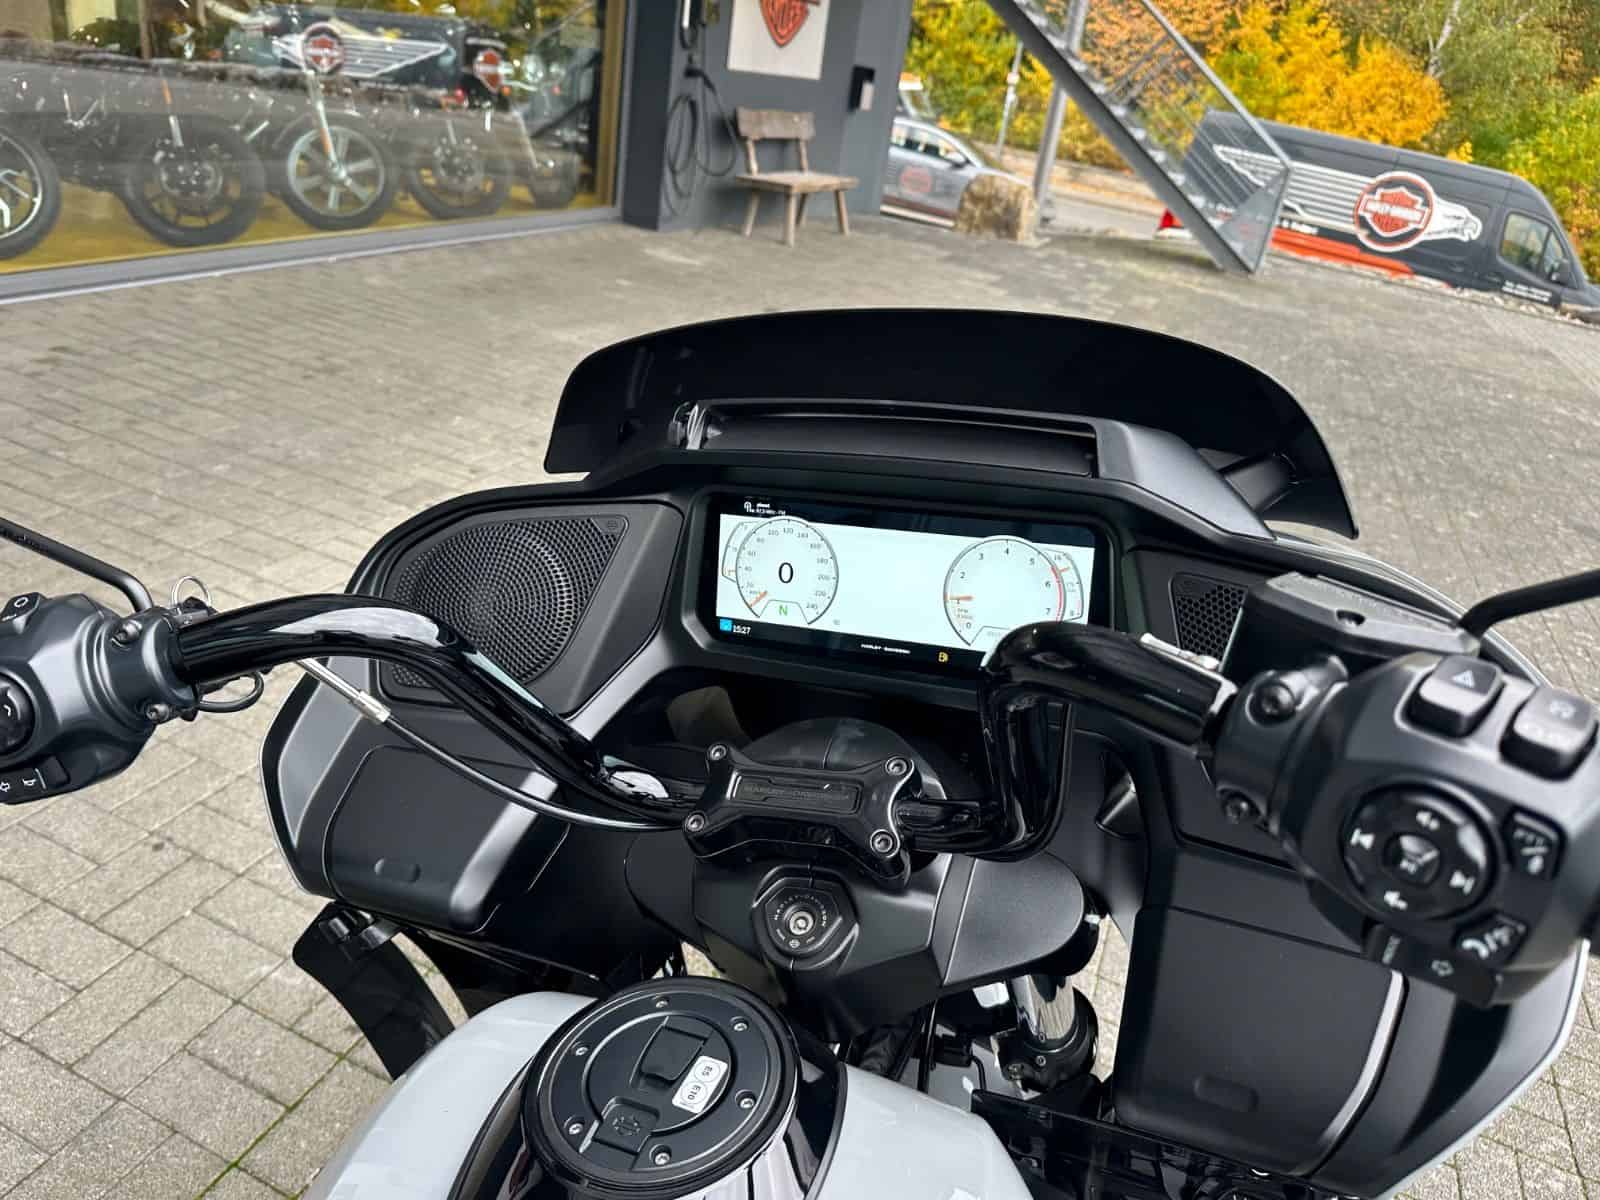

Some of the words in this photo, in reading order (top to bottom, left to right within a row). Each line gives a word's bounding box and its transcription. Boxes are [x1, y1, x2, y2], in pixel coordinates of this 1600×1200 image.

[1004, 547, 1010, 556] 4
[978, 552, 985, 561] 3
[1029, 557, 1036, 566] 5
[778, 562, 794, 583] 0
[959, 571, 967, 580] 2
[1044, 580, 1052, 590] 6
[779, 604, 788, 616] N
[1044, 606, 1051, 617] 7
[965, 621, 972, 630] 0
[686, 1084, 702, 1101] E10
